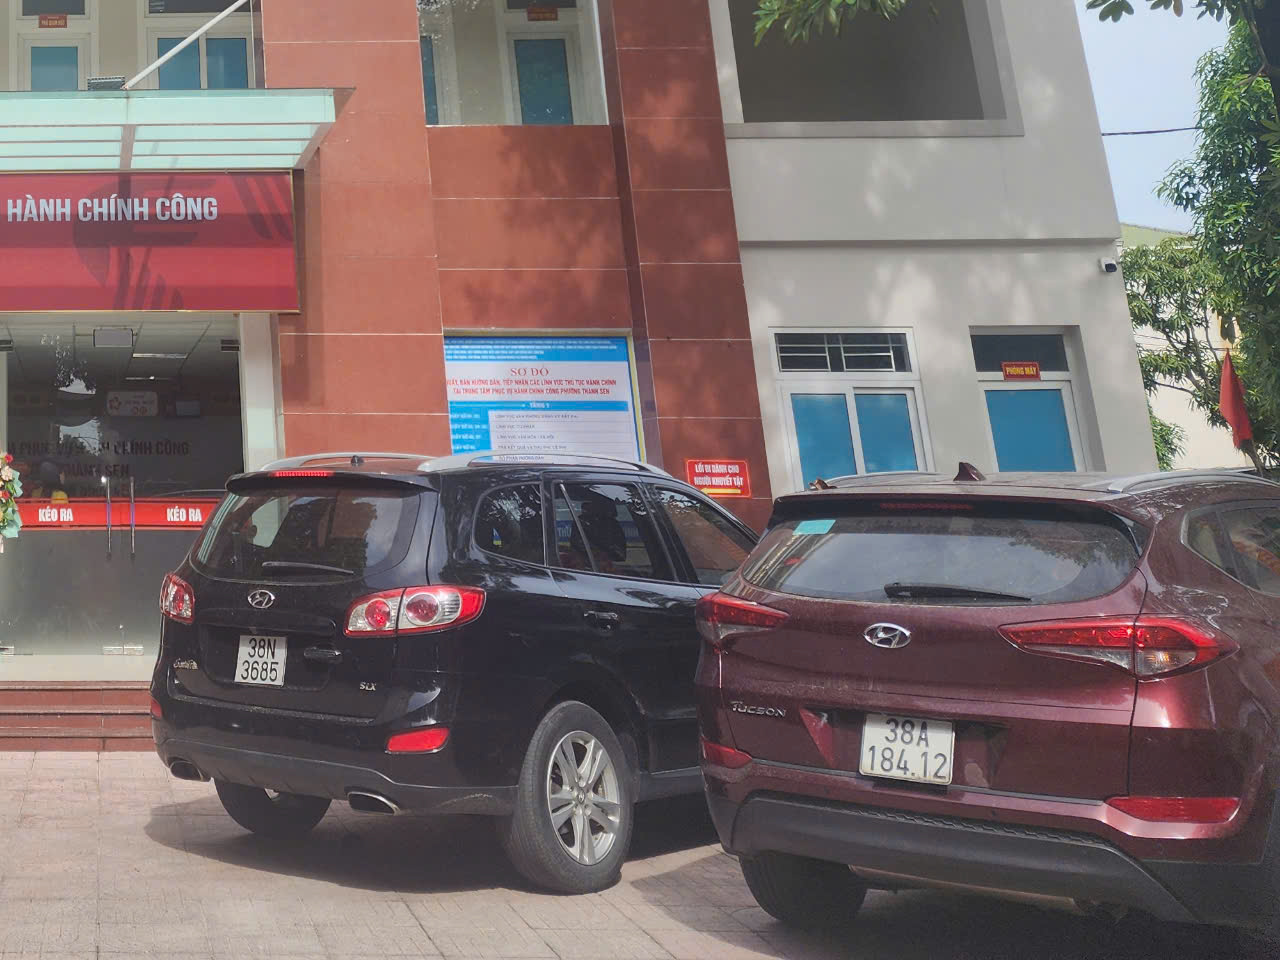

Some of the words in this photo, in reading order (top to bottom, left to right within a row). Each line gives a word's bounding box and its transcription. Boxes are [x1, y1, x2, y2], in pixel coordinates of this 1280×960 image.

[7, 194, 71, 222] HÀNH
[78, 193, 149, 222] CHÍNH
[155, 193, 218, 221] CÔNG
[728, 464, 739, 473] CHO
[38, 506, 58, 522] KÉO
[59, 508, 74, 522] RA
[166, 506, 186, 522] KÉO
[188, 508, 202, 522] RA
[247, 638, 276, 659] 38N
[240, 661, 279, 682] 3685
[359, 681, 377, 692] SLX
[884, 718, 929, 748] 38A
[868, 745, 948, 780] 184.12
